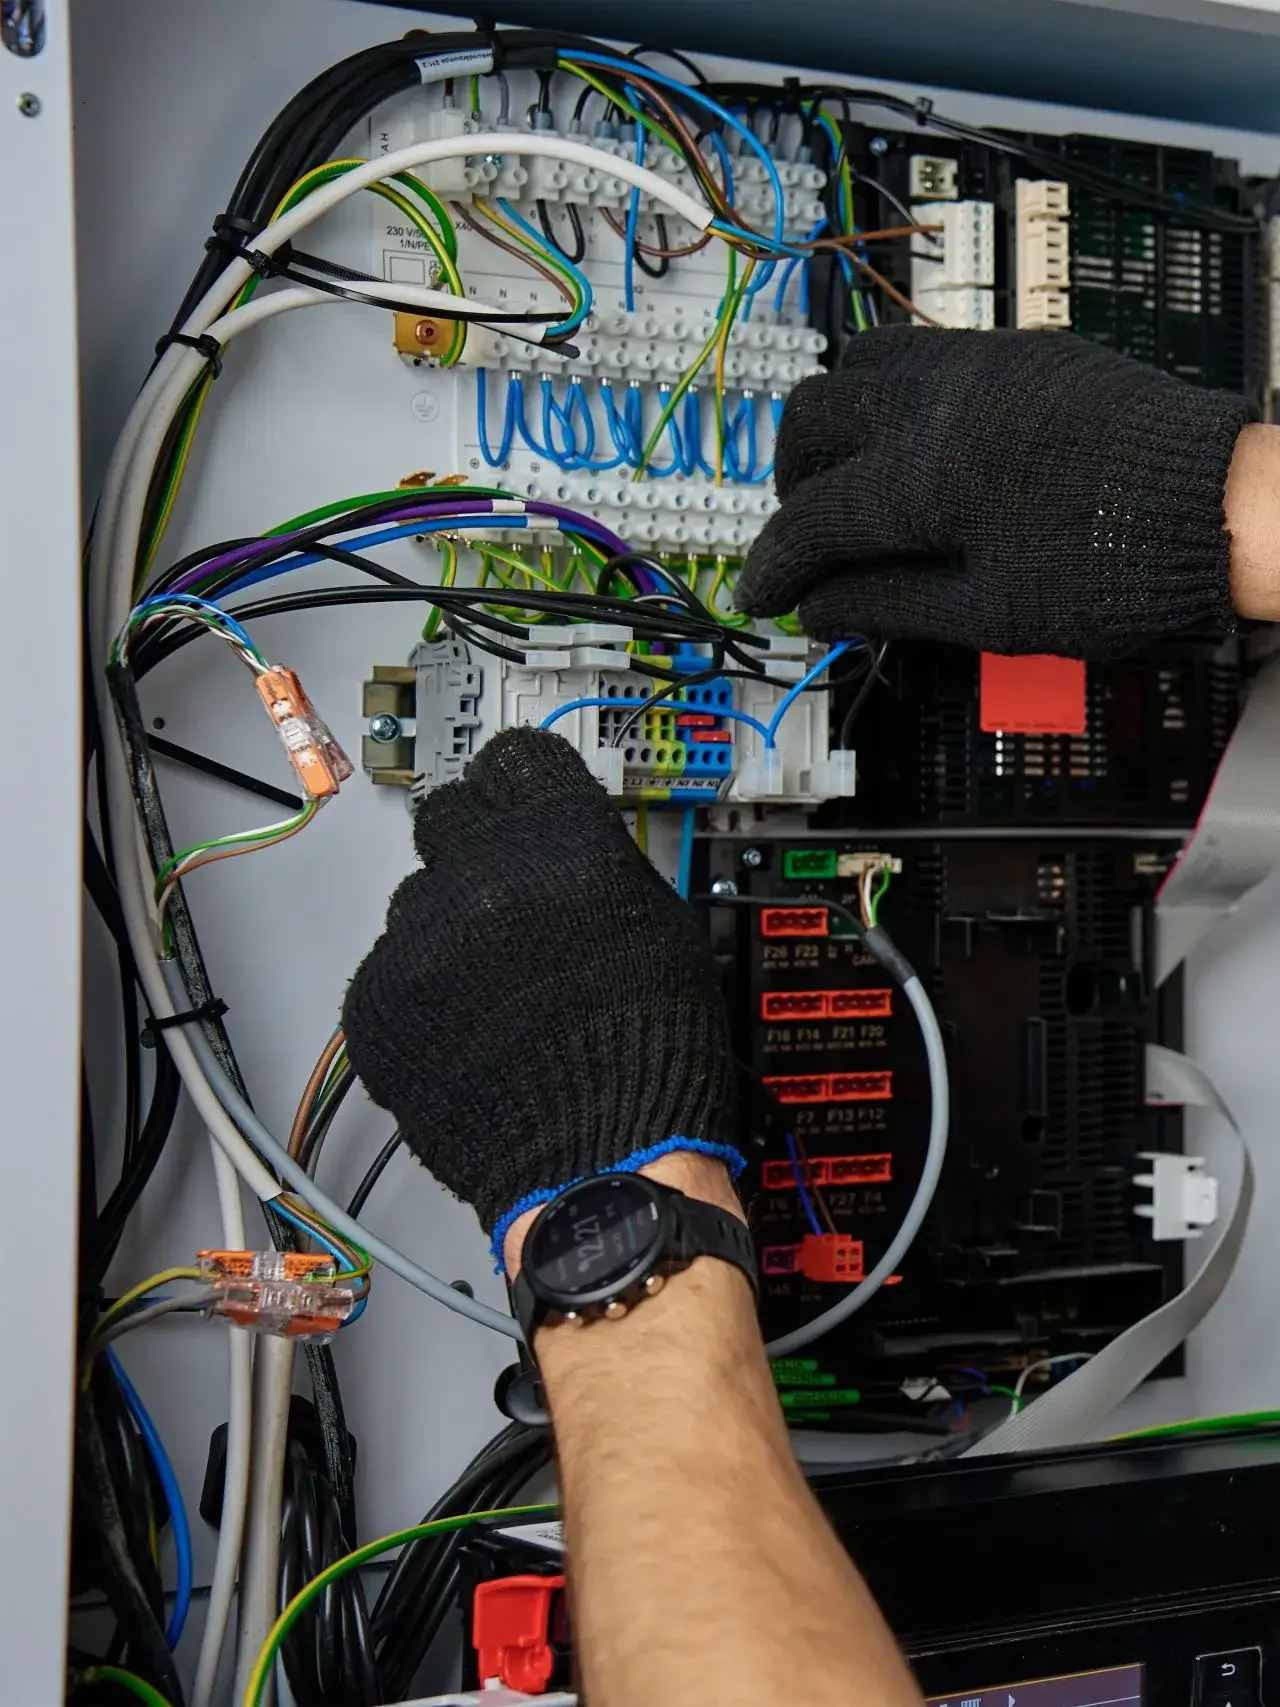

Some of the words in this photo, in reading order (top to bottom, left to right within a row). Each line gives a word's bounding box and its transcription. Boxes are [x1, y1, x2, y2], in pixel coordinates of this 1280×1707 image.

[386, 226, 404, 237] 230
[469, 286, 477, 295] N
[500, 289, 507, 298] N
[530, 292, 537, 301] N
